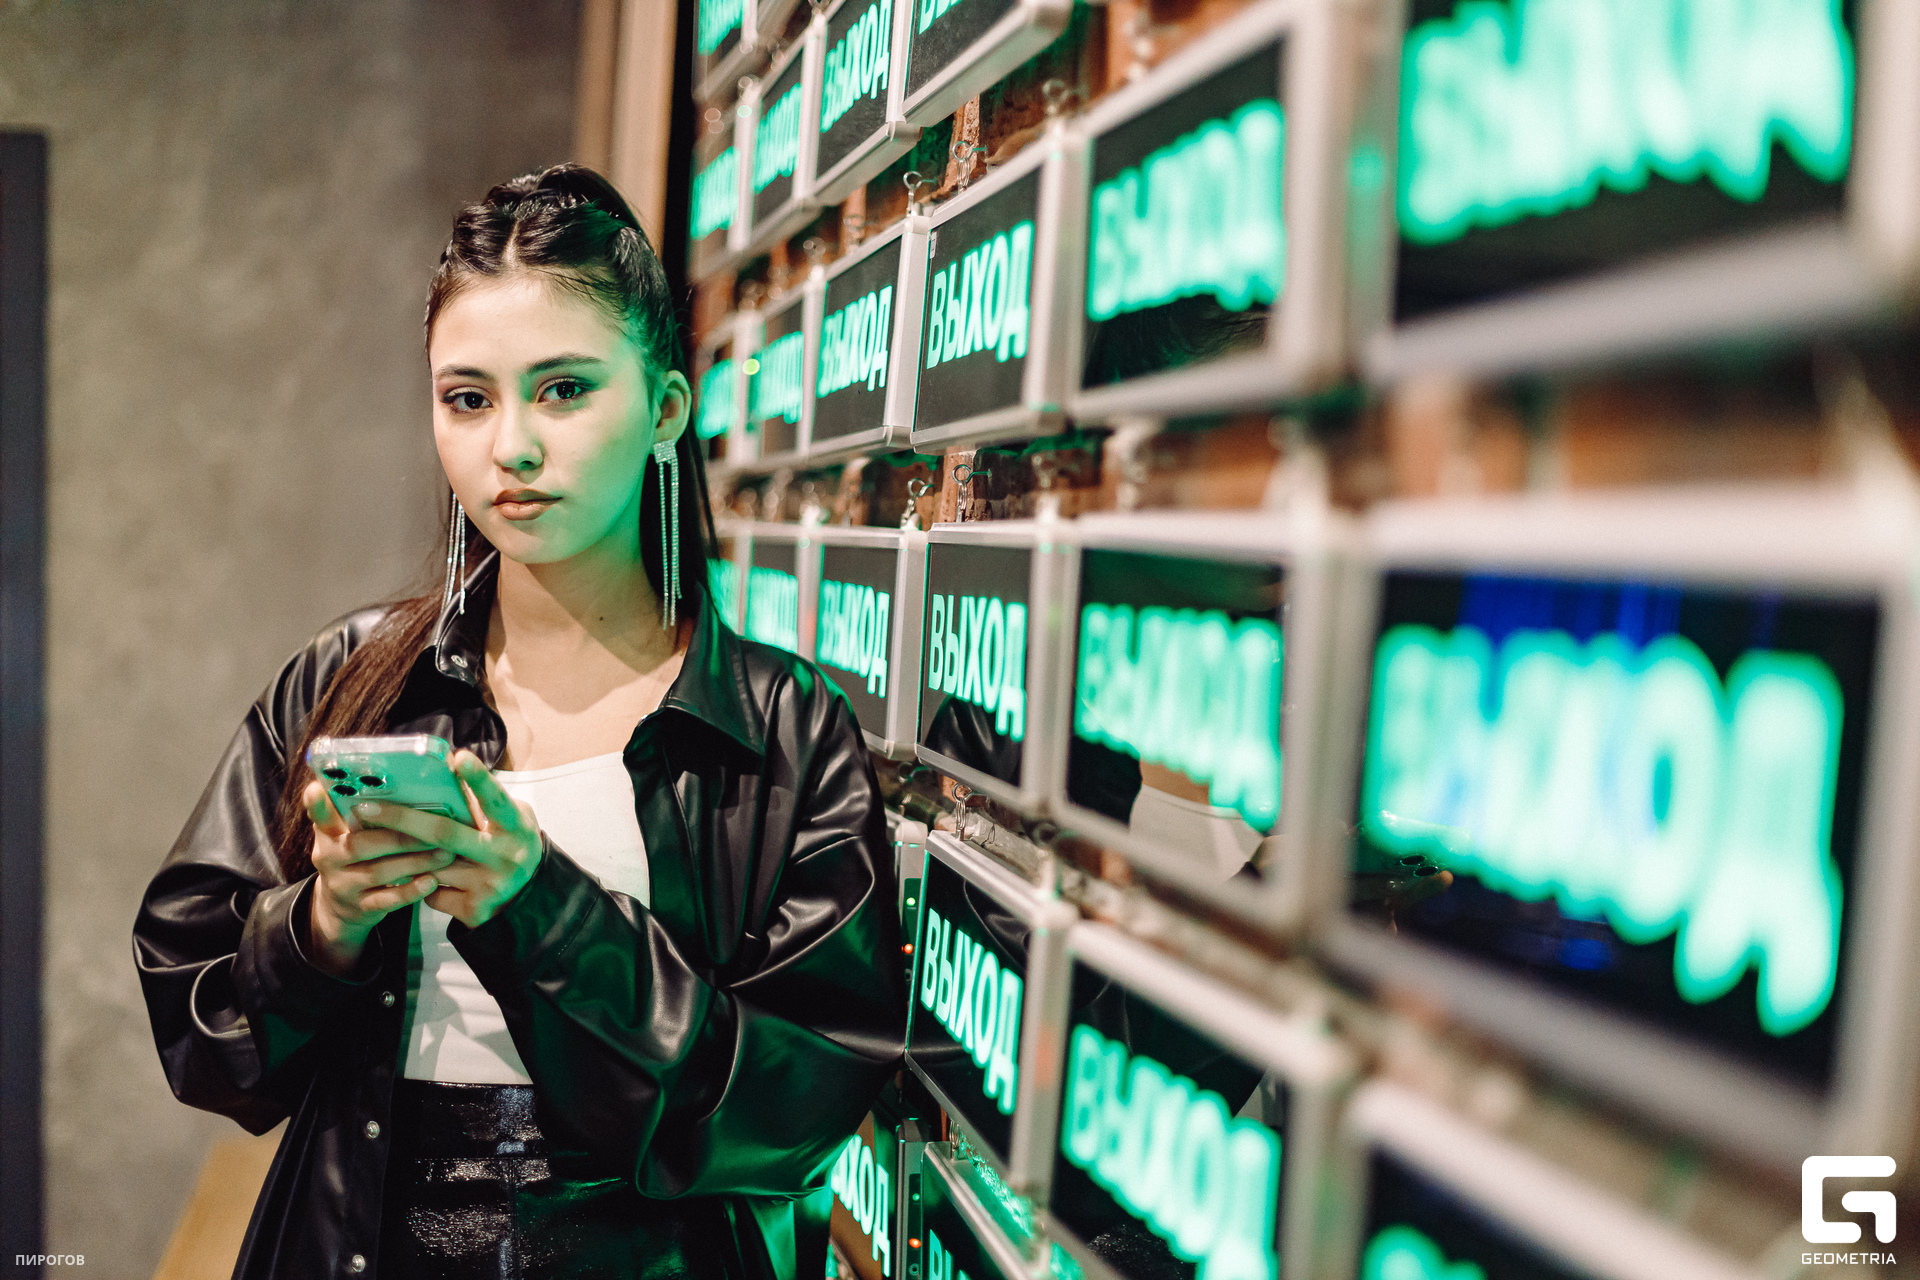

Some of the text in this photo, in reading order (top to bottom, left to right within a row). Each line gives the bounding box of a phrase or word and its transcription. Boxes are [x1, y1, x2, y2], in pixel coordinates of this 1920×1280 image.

[819, 0, 892, 133] ВЫХОД
[815, 285, 892, 398] ВЫХОД
[926, 220, 1034, 362] ВЫХОД
[812, 579, 890, 698] ВЫХОД
[928, 594, 1028, 742] ВЫХОД
[921, 908, 1023, 1115] ВЫХОД
